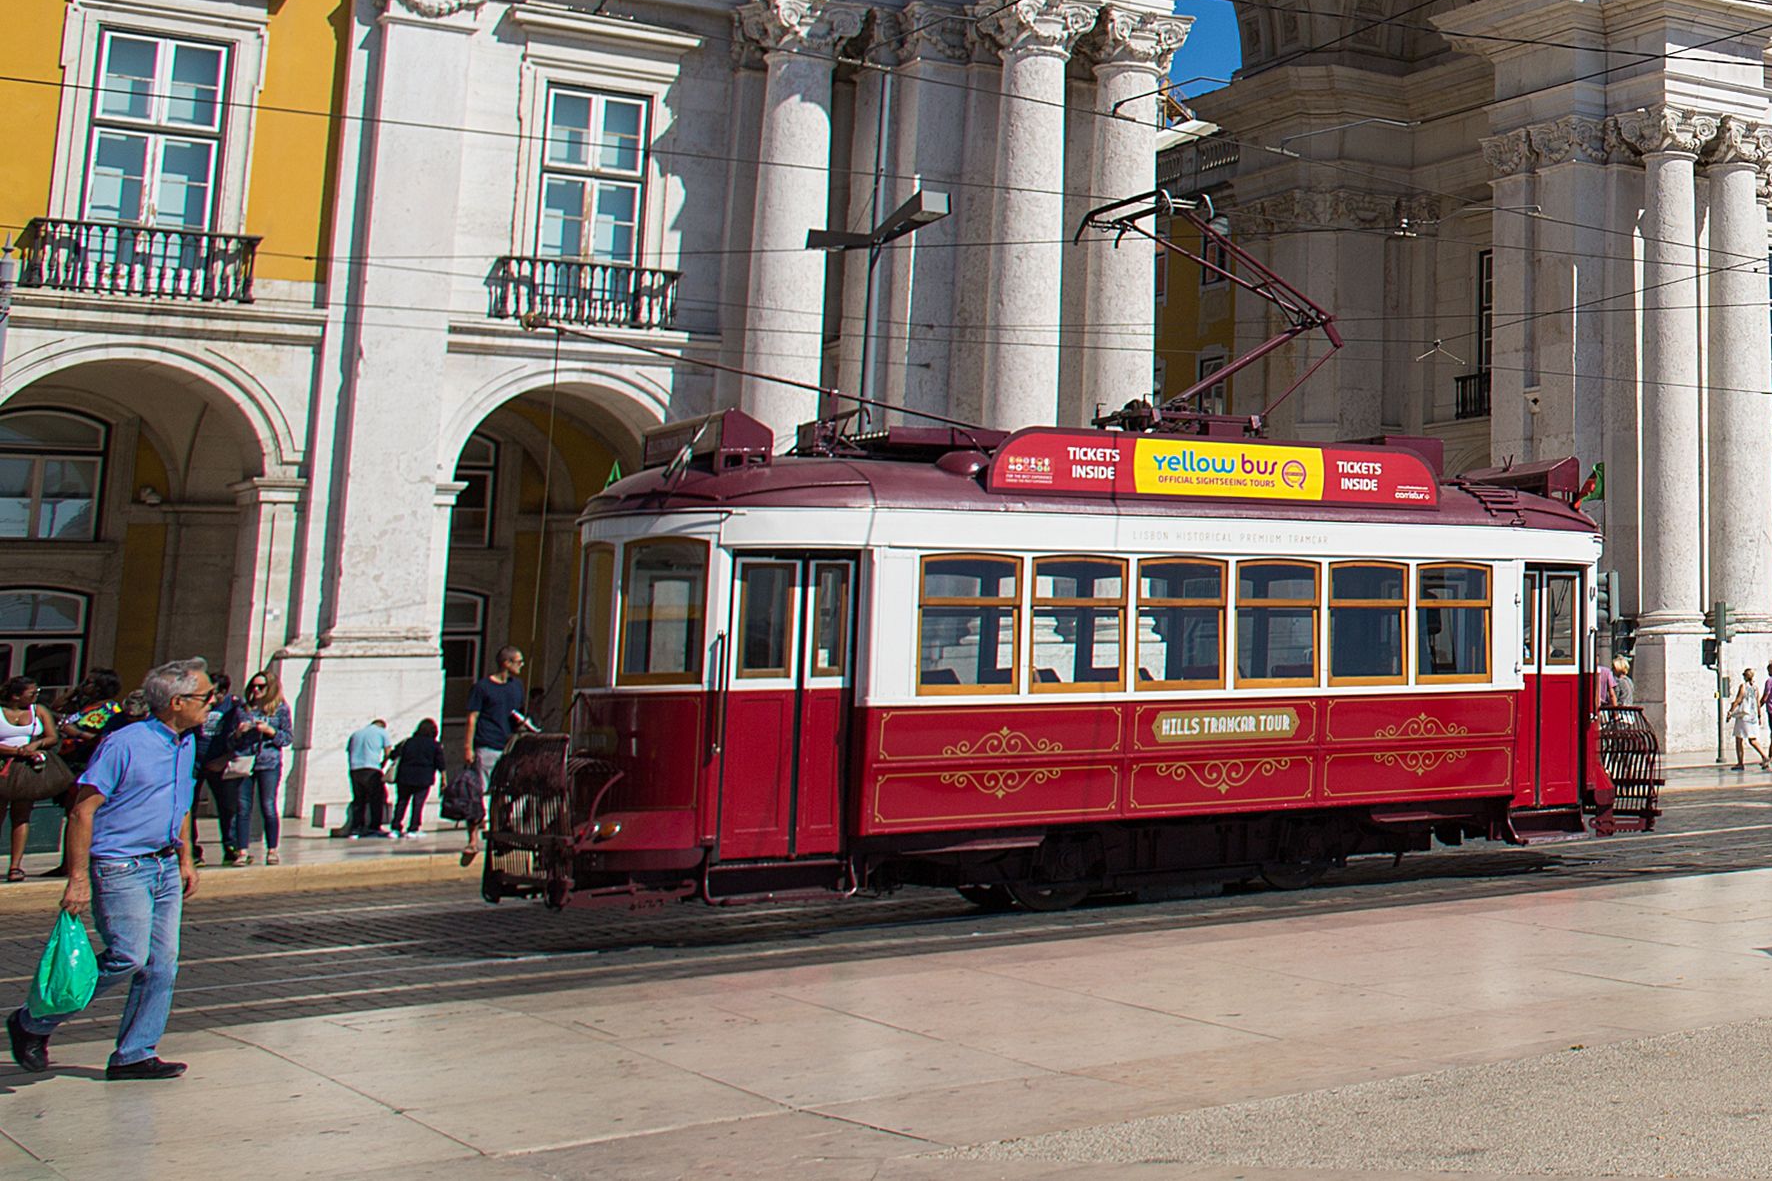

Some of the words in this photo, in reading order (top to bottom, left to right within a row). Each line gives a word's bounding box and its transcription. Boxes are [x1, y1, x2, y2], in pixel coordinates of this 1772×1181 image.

[1067, 446, 1120, 462] TICKETS
[1241, 453, 1278, 475] bus
[1336, 461, 1382, 475] TICKETS
[1072, 464, 1116, 480] INSIDE
[1158, 475, 1194, 485] OFFICIAL
[1196, 476, 1248, 487] SIGHTSEEING
[1249, 479, 1276, 488] TOURS
[1341, 477, 1378, 491] INSIDE
[1133, 530, 1169, 540] LISBON
[1176, 531, 1232, 543] HISTORICAL
[1240, 533, 1282, 544] PREMIUM
[1288, 534, 1329, 545] TRAMCAR
[1161, 717, 1200, 736] HILLS
[1203, 715, 1256, 734] TRAMCAR
[1259, 714, 1291, 731] TOUR
